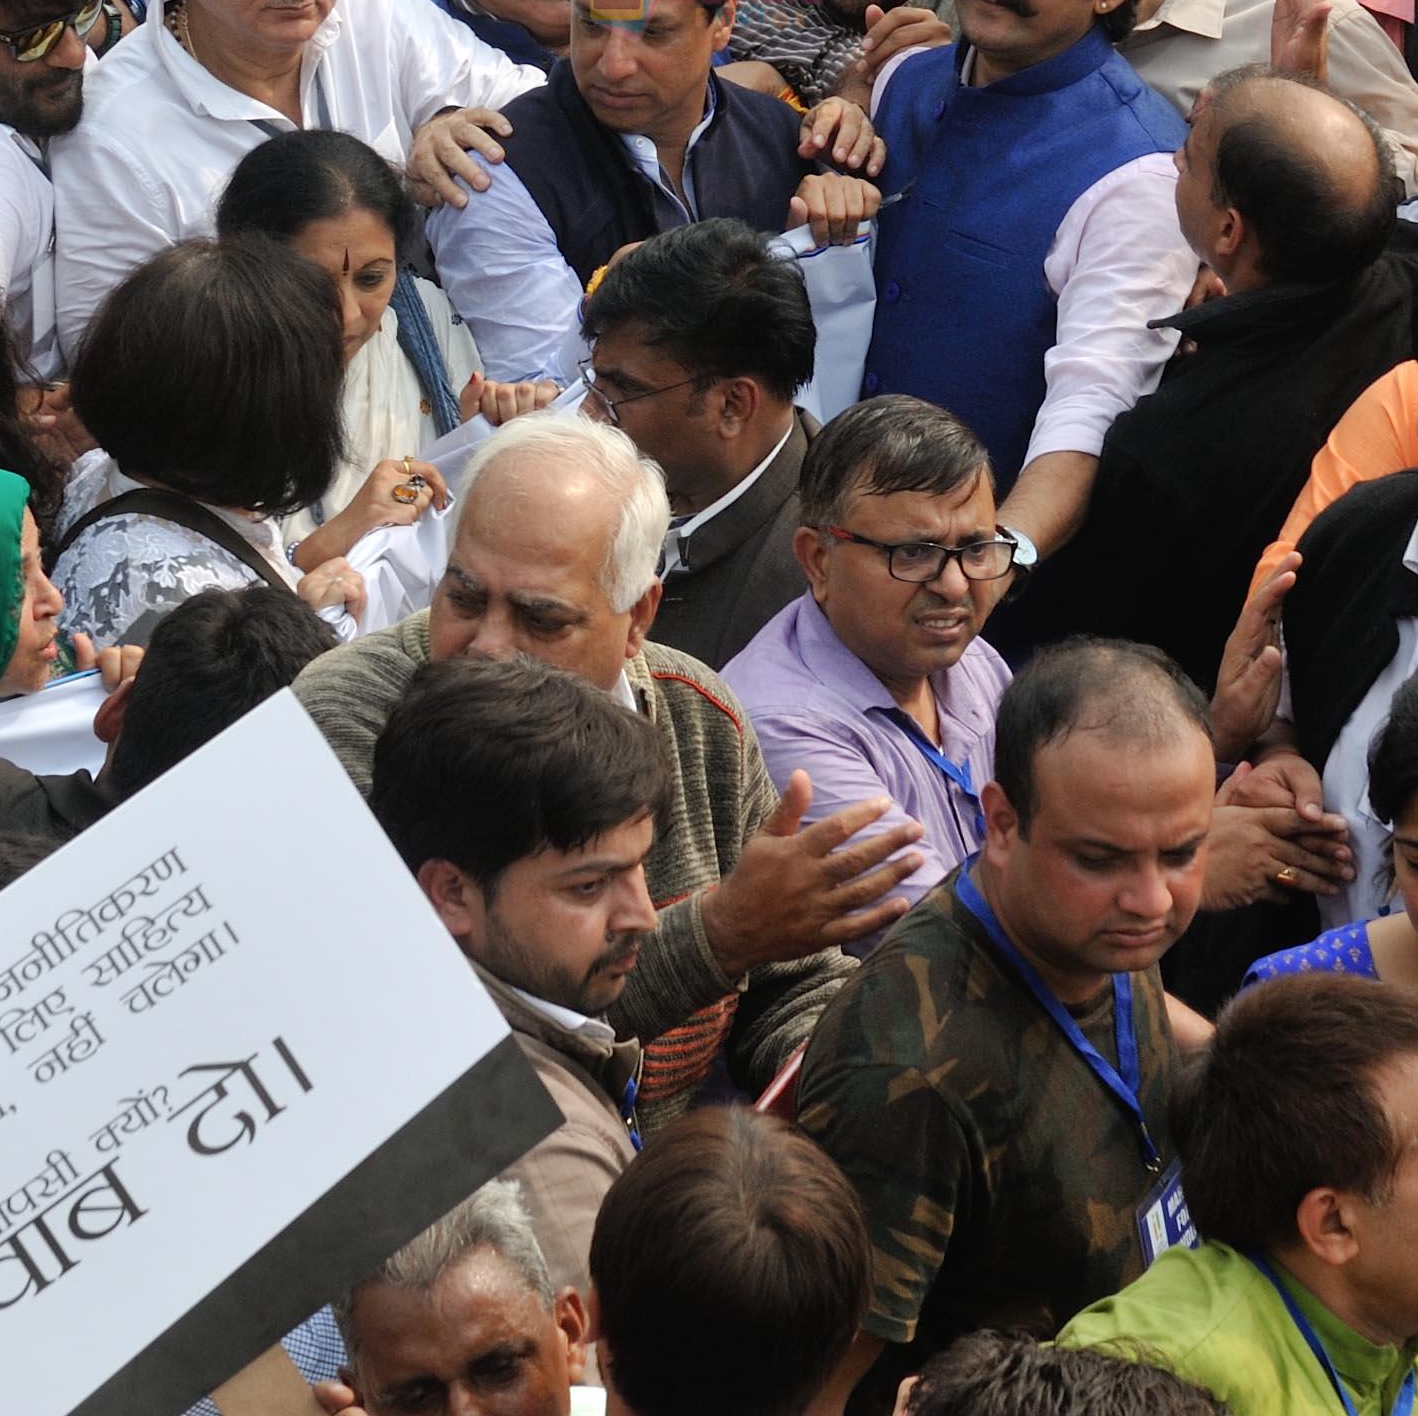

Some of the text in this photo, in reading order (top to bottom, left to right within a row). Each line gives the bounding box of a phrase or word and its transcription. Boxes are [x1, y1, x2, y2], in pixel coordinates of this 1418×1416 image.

[80, 883, 213, 987] साहित्य
[27, 1011, 106, 1084] नहीं
[119, 920, 240, 1014] चलेगा।
[92, 1086, 170, 1155] क्यों?
[167, 1036, 314, 1157] दो।
